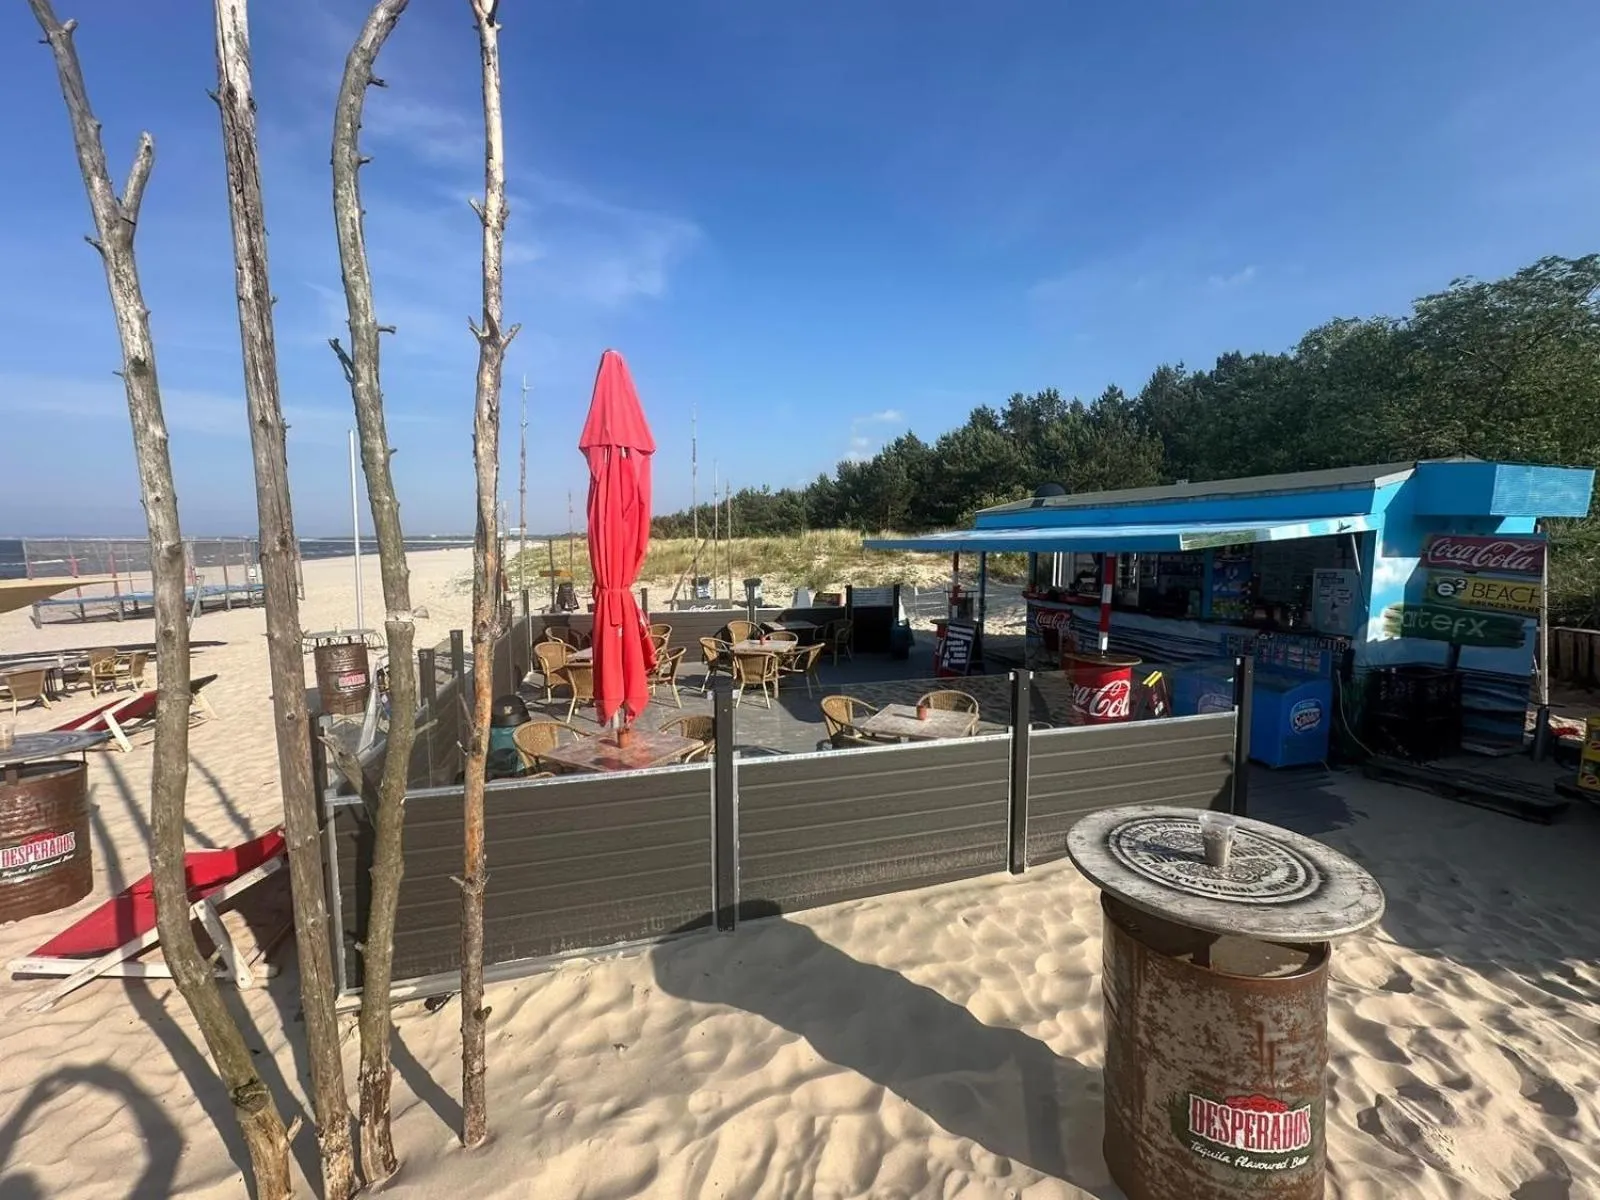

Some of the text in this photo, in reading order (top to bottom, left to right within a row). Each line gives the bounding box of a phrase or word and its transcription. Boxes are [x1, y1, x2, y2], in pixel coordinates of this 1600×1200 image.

[1, 833, 75, 868] DESPERADOS
[1190, 1097, 1310, 1151] DESPERADOS
[1190, 1140, 1231, 1163] Tequila
